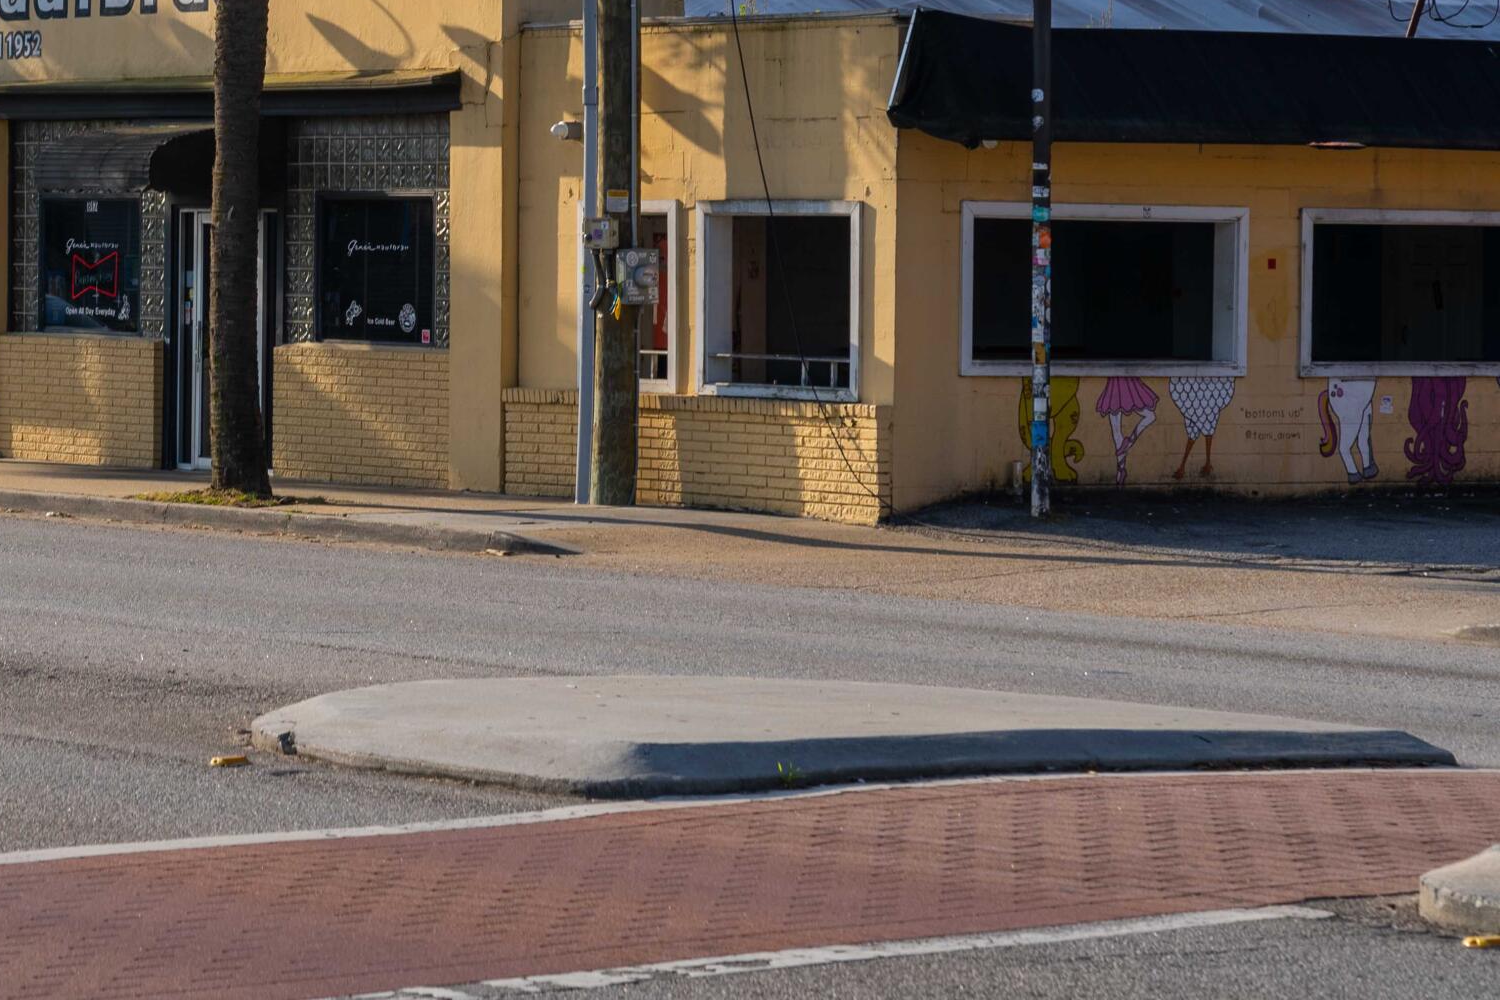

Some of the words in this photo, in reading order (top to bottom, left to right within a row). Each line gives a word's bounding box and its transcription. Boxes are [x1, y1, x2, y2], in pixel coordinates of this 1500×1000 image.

[6, 30, 42, 60] 1952
[65, 306, 77, 316] Open
[85, 307, 94, 316] Day
[95, 307, 116, 318] Everyday
